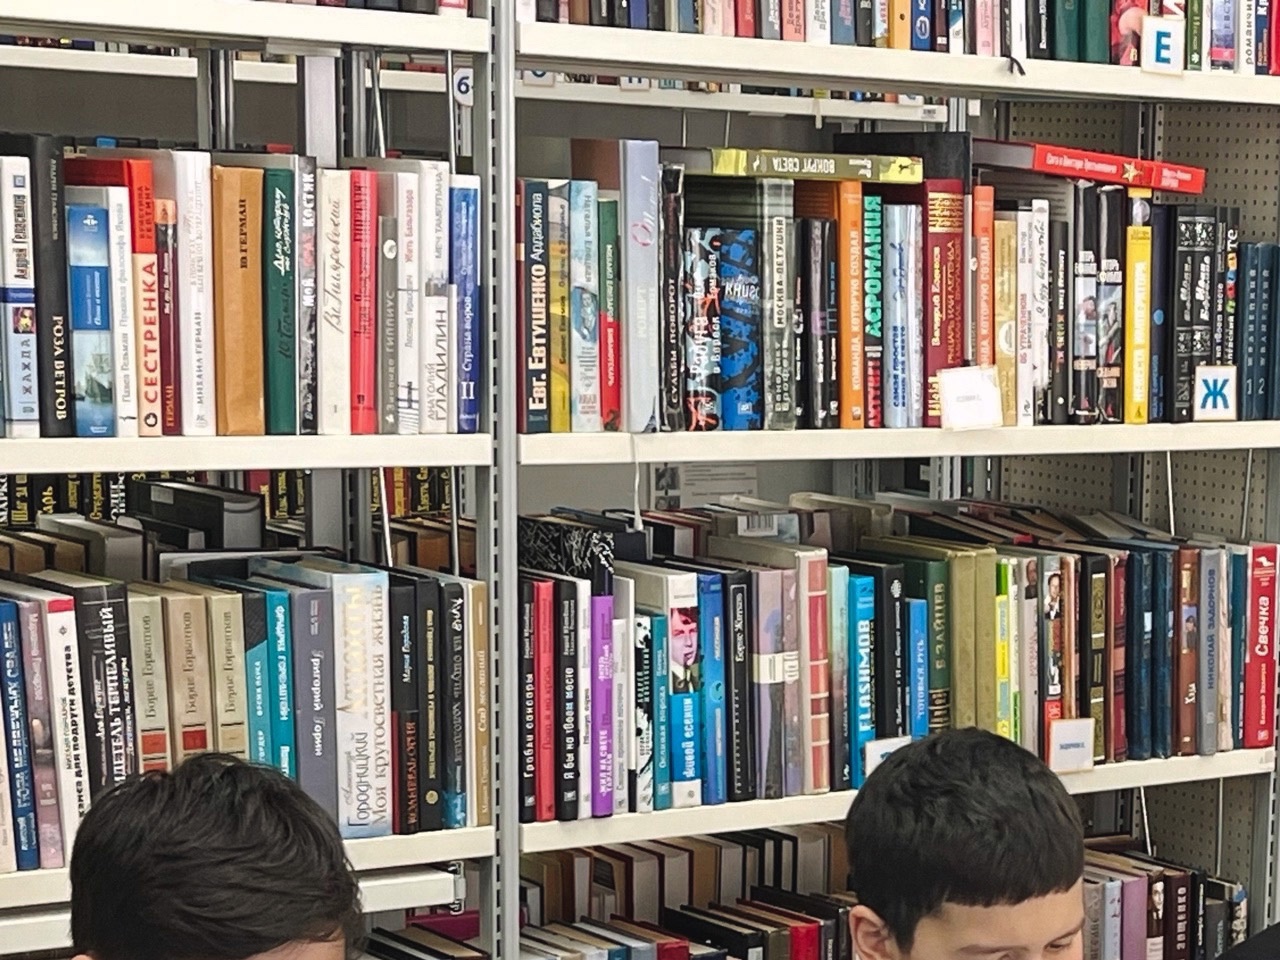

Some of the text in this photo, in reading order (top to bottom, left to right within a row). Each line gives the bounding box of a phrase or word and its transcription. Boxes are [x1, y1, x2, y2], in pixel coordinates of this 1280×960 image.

[457, 76, 470, 95] 6
[530, 193, 544, 261] Ардабиола
[53, 316, 67, 420] РОЗА ВЕТРОВ
[141, 262, 157, 403] СЕСТРЕНКА
[436, 310, 446, 421] ГЛАДИЛИН
[529, 264, 546, 369] ЕВТУШЕНКО
[1200, 378, 1230, 409] Ж
[858, 619, 871, 732] FLASHMOB
[1206, 569, 1216, 689] НИКОЛАЙ ЗАДОРНОВ
[1256, 596, 1270, 656] Свечка
[99, 607, 126, 783] ИДЕТЕЛЬ ТЕРПЕЛИВЫЙ
[311, 650, 325, 756] Григорий Горин
[371, 585, 390, 825] Моя кругосветная жизнь
[348, 732, 373, 826] Городницкий
